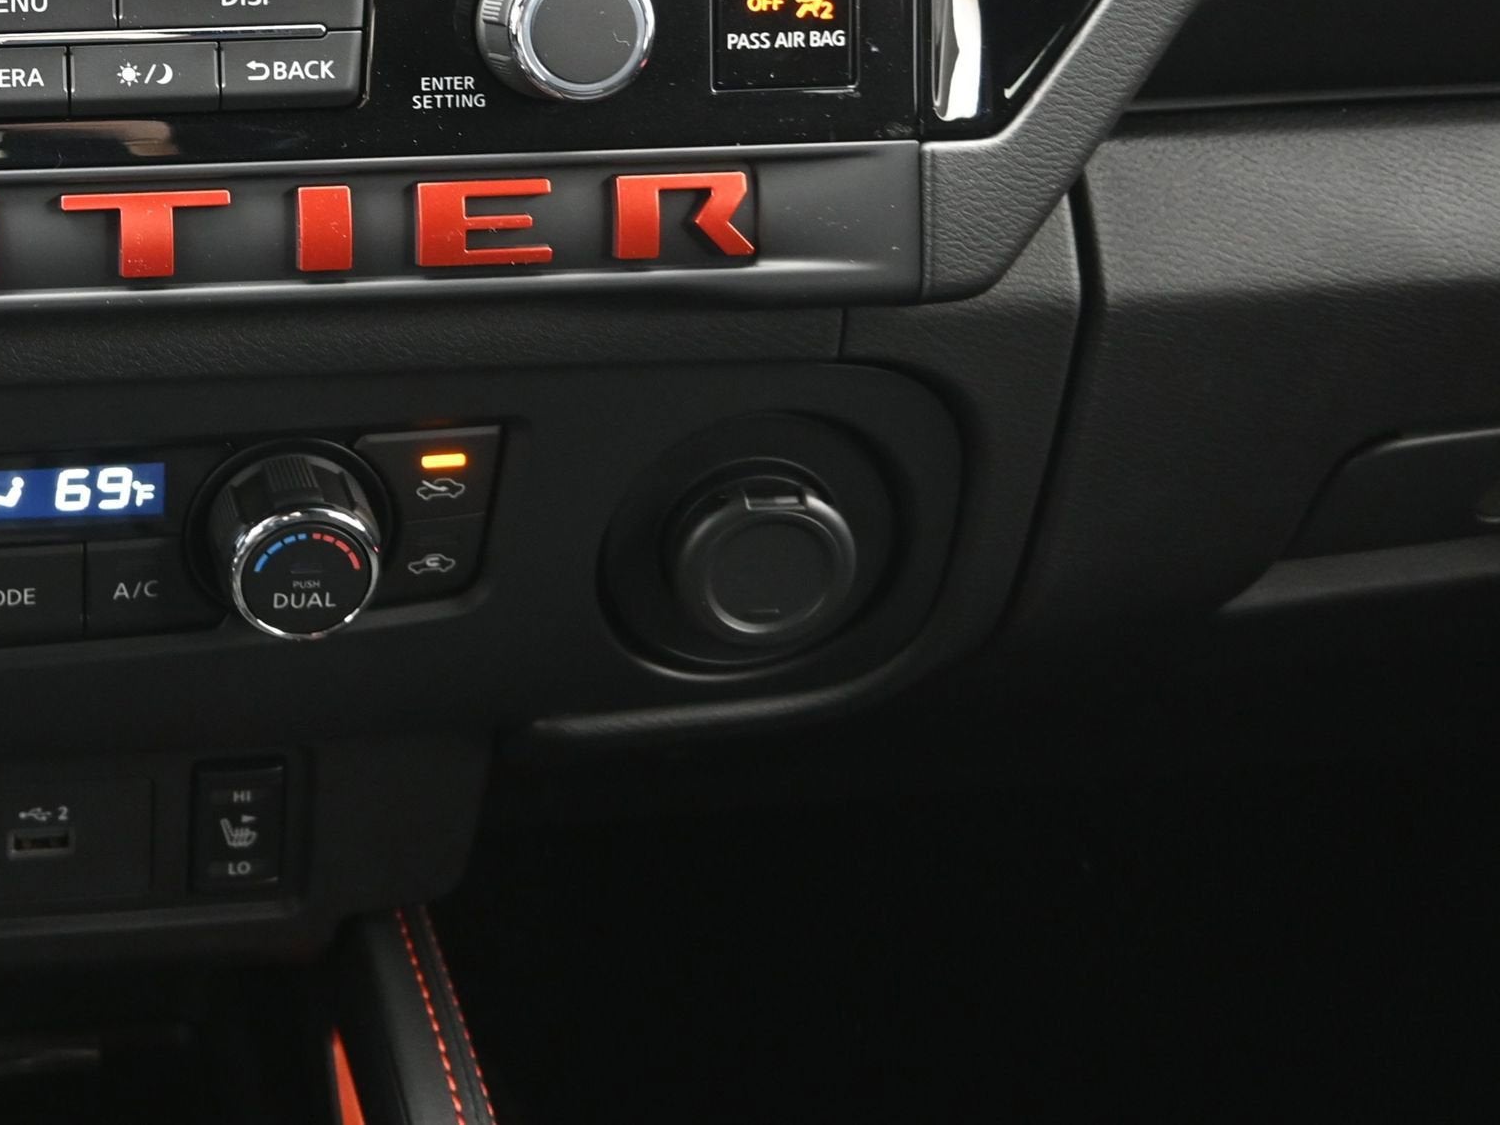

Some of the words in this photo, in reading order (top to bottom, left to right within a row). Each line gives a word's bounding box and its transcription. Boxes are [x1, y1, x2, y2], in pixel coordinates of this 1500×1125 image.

[727, 32, 771, 50] PASS
[774, 30, 806, 49] AIR
[809, 29, 846, 48] BAG
[273, 60, 336, 81] BACK
[420, 75, 475, 92] ENTER
[412, 93, 486, 110] SETTING
[112, 579, 159, 600] A/C
[292, 580, 321, 589] PUSH
[273, 591, 336, 609] DUAL
[232, 790, 252, 803] HI
[227, 861, 252, 876] LO
